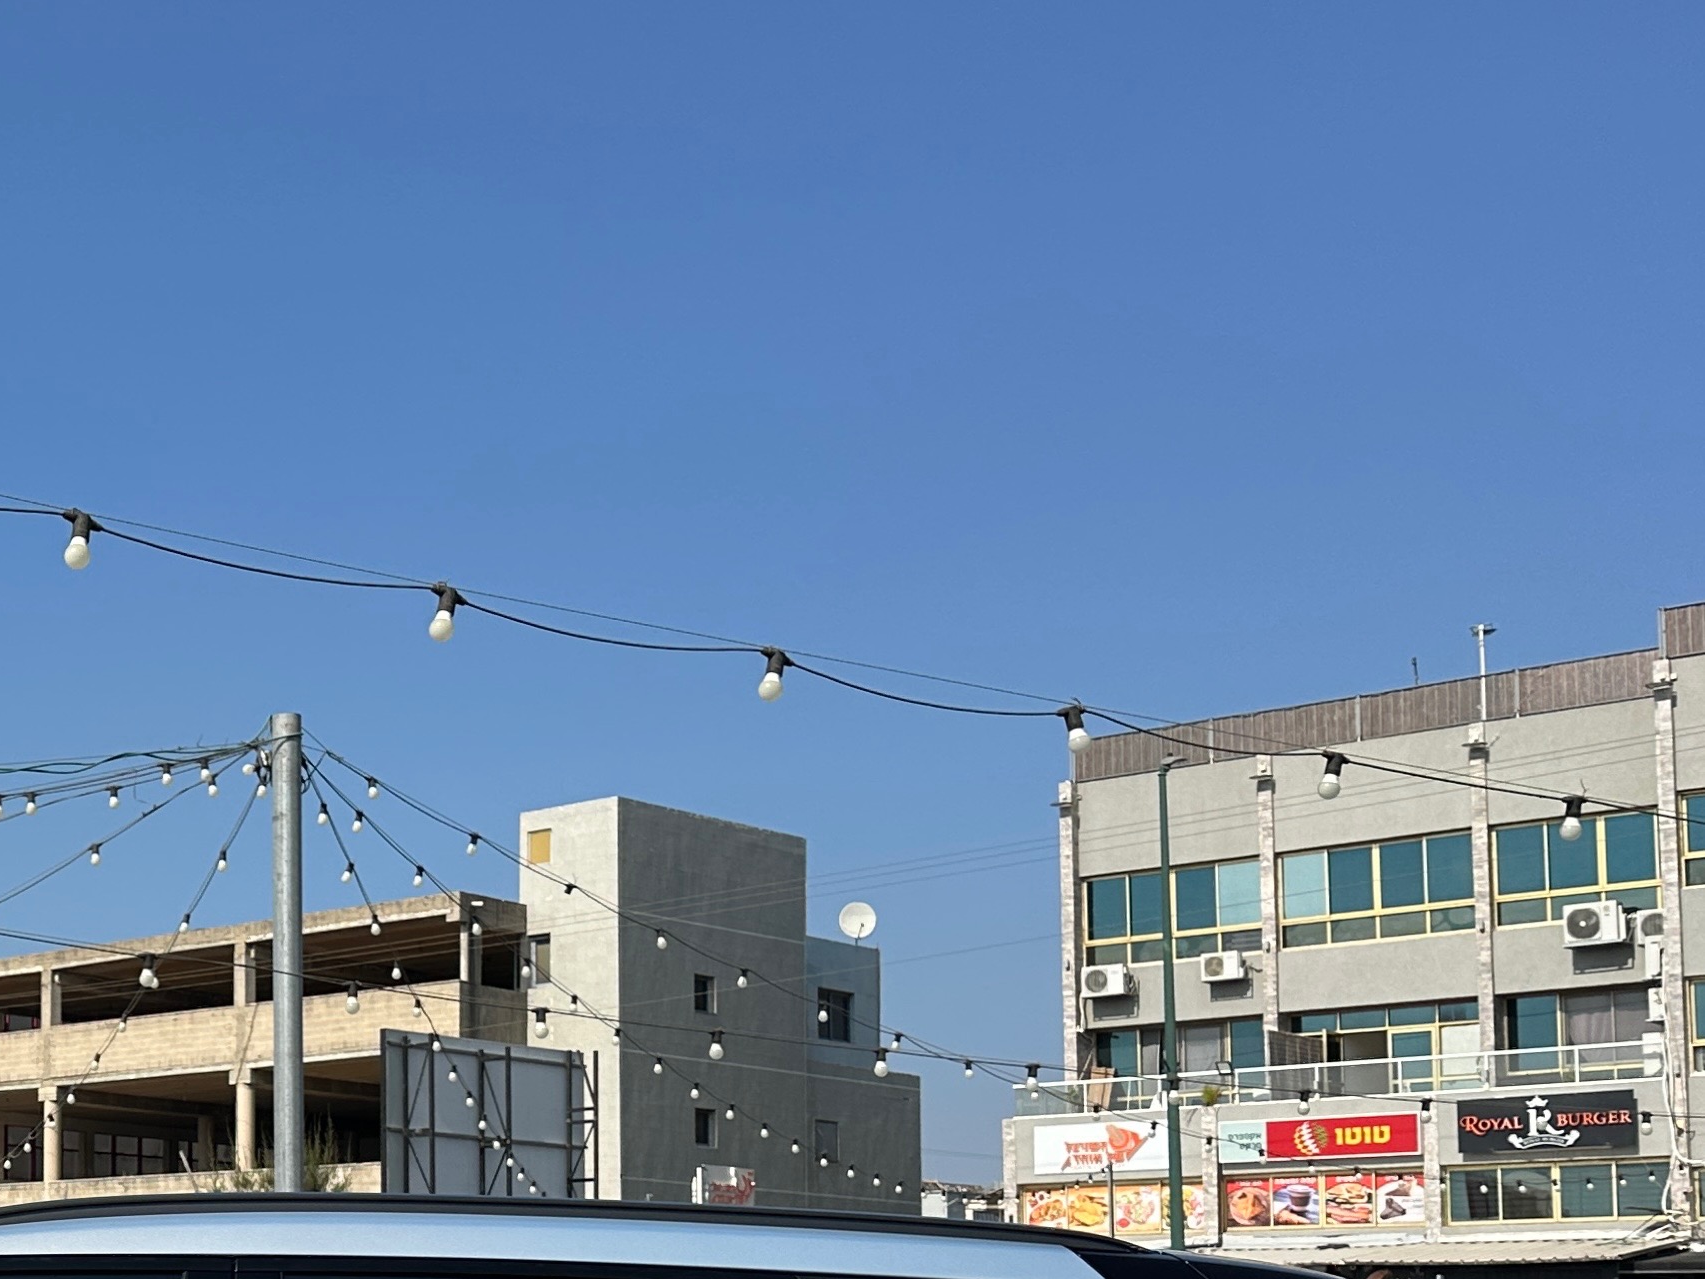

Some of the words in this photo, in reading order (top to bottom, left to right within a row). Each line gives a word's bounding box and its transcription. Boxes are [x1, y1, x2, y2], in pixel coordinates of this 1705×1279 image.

[1459, 1115, 1524, 1136] ROYAL
[1556, 1109, 1633, 1128] BURGER
[1334, 1124, 1391, 1146] טוטו
